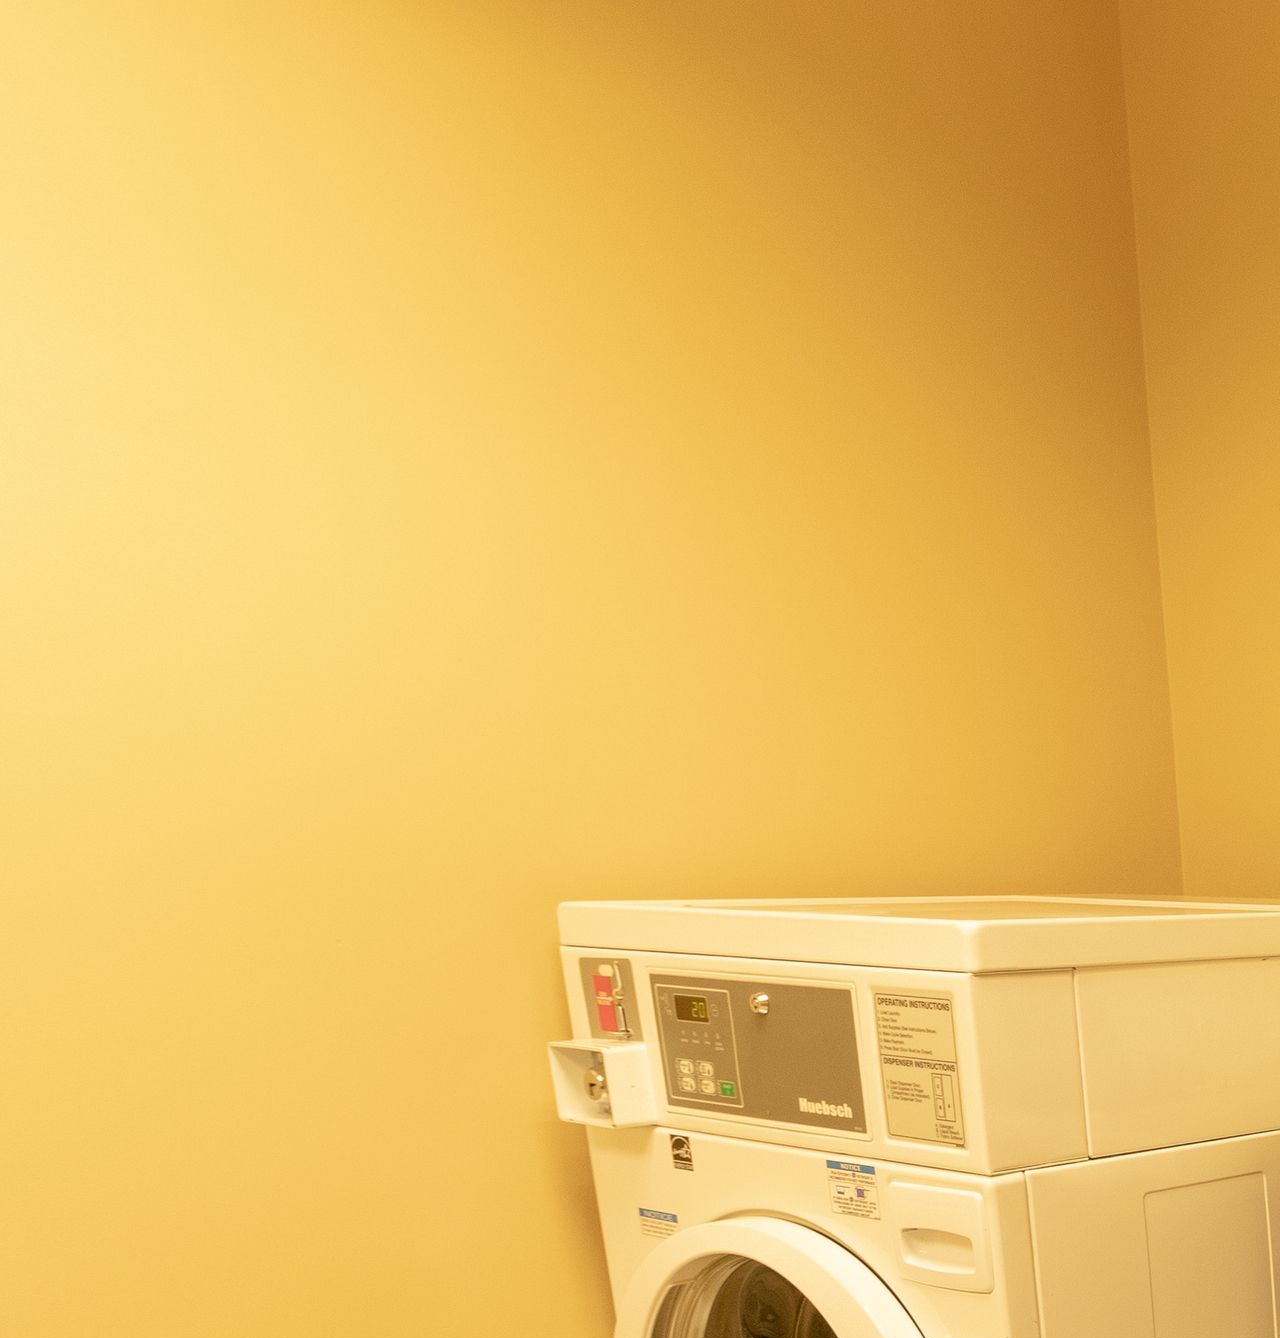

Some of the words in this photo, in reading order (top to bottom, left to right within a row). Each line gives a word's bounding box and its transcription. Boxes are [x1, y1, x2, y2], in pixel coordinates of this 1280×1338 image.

[877, 997, 907, 1007] OPERATING
[909, 1000, 949, 1011] INSTRUCTIONS
[883, 1057, 913, 1066] DISPENSER
[914, 1061, 955, 1071] INSTRUCTIONS
[798, 1097, 853, 1119] Huebsch
